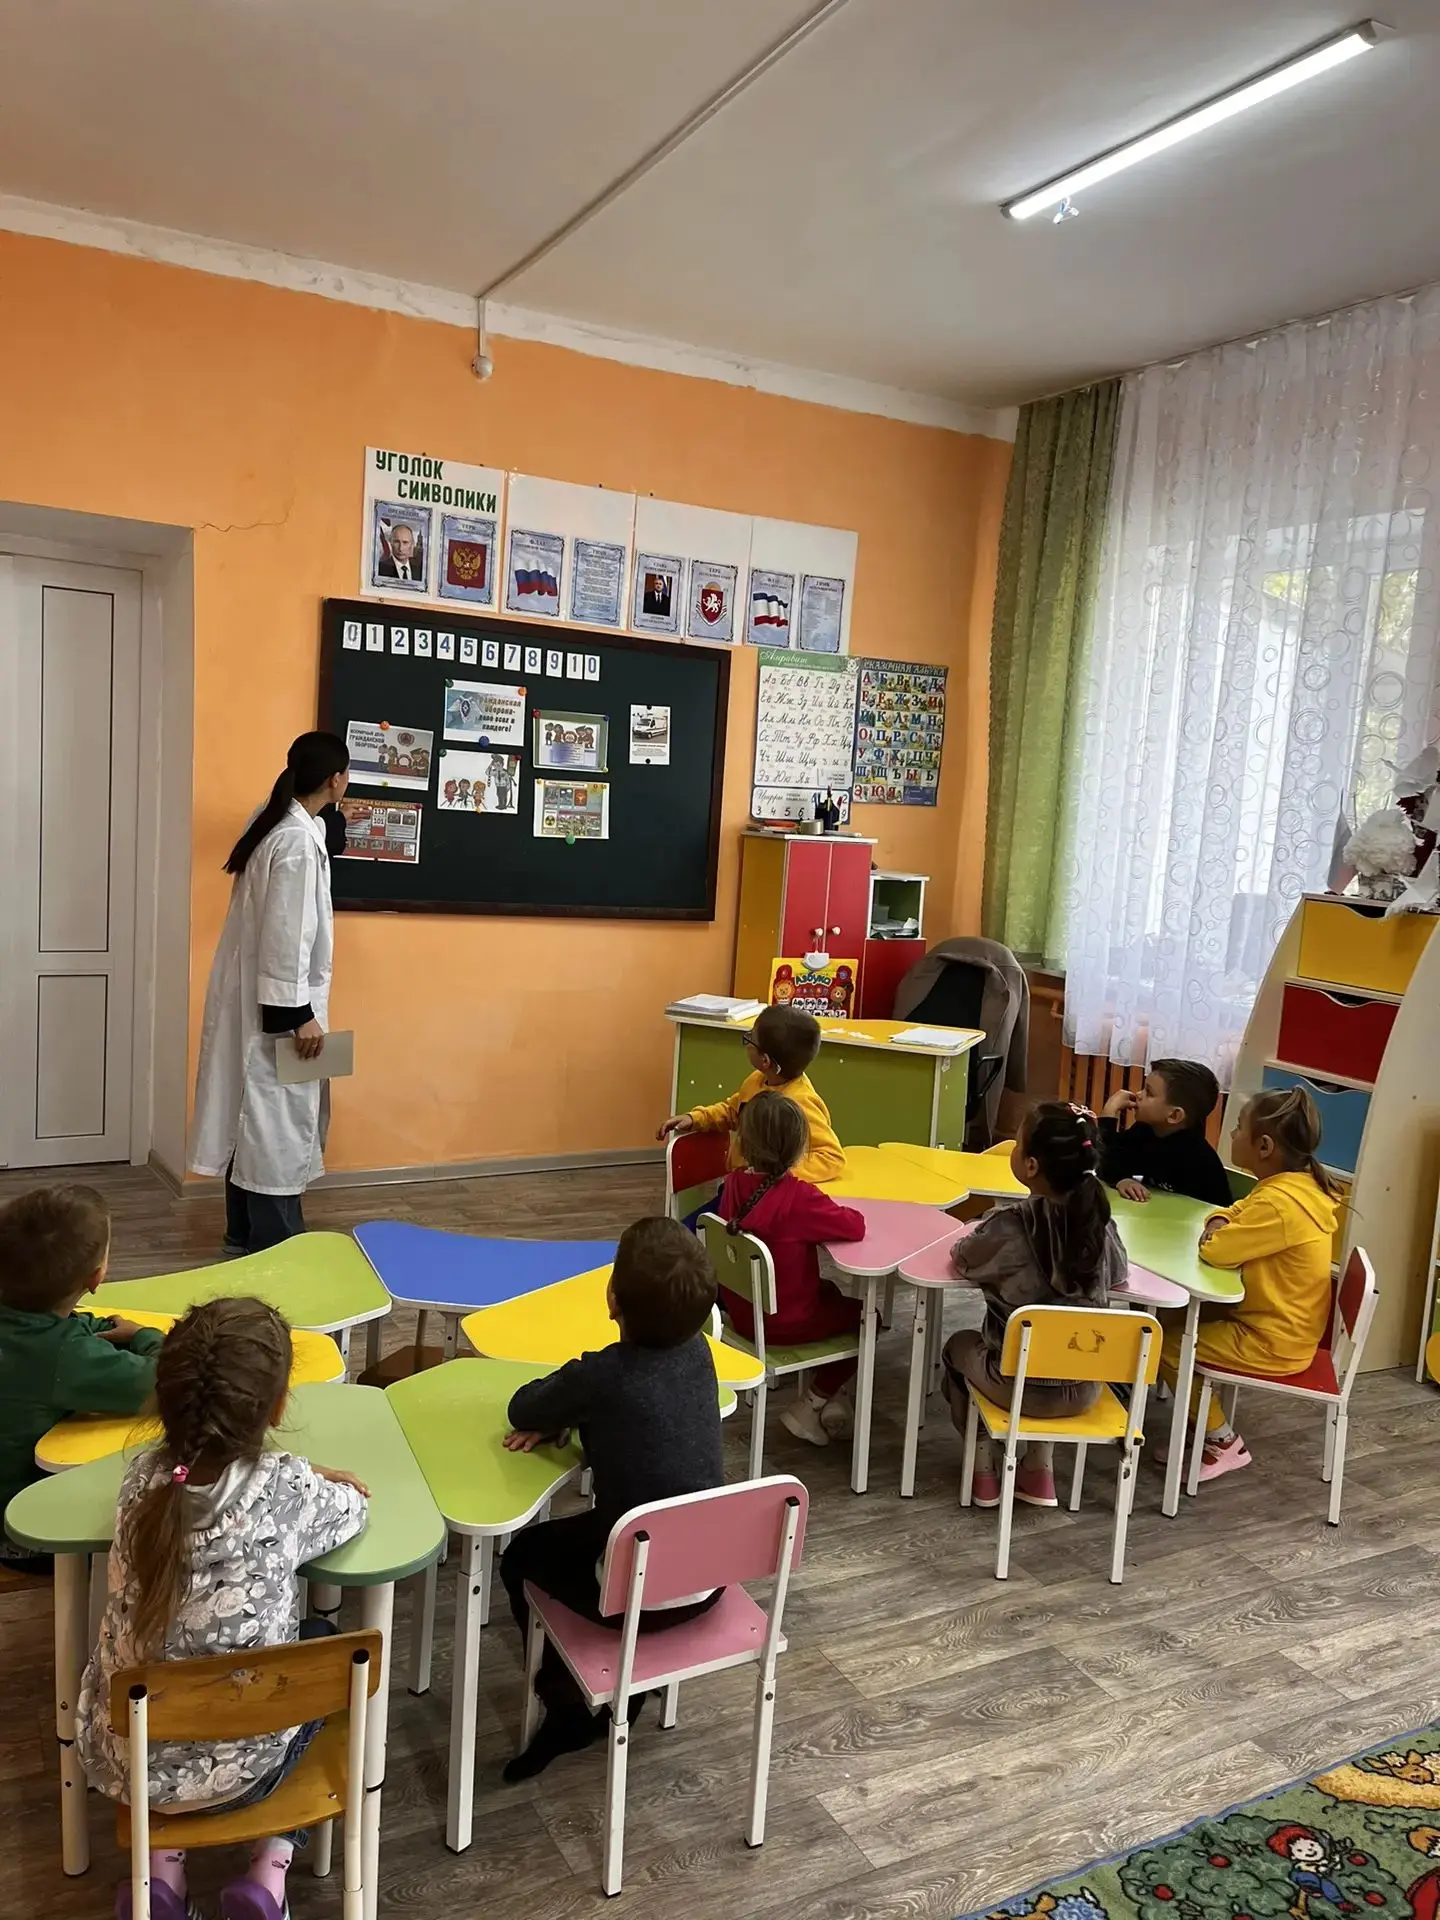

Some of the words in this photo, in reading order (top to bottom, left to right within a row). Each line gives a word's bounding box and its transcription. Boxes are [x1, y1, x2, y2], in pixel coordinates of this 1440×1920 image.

[376, 450, 444, 480] УГОЛОК
[397, 478, 497, 514] СИМВОЛИКИ
[347, 623, 358, 642] 0
[372, 626, 378, 644] 1
[394, 630, 404, 647] 2
[418, 632, 428, 650] 3
[440, 636, 450, 653] 4
[464, 639, 474, 657] 5
[486, 644, 495, 661] 6
[508, 646, 516, 664] 7
[528, 650, 538, 667] 8
[550, 652, 559, 670] 9
[864, 659, 912, 673] СКАЗОЧНАЯ
[862, 671, 872, 684] А
[880, 673, 888, 685] Б
[896, 674, 904, 686] В
[913, 676, 920, 687] Г
[862, 690, 869, 702] Е
[894, 693, 906, 705] Ж
[912, 694, 918, 706] З
[928, 696, 938, 707] И
[877, 711, 886, 722] К
[894, 712, 902, 723] Л
[911, 713, 921, 725] М
[927, 714, 938, 726] Н
[859, 728, 868, 740] О
[876, 730, 886, 741] П
[893, 730, 900, 742] Р
[910, 732, 918, 744] С
[926, 733, 934, 744] Т
[858, 748, 866, 758] У
[874, 748, 884, 760] Ф
[892, 750, 901, 760] Х
[914, 751, 922, 764] Ц
[926, 752, 934, 762] Ч
[856, 766, 867, 776] Ш
[876, 767, 888, 780] Щ
[892, 768, 902, 780] Ъ
[906, 768, 918, 780] Ы
[926, 770, 934, 781] Ь
[854, 784, 862, 797] Э
[871, 786, 885, 797] Ю
[887, 786, 896, 798] Я
[756, 806, 762, 815] 3
[770, 806, 776, 815] 4
[784, 807, 791, 816] 5
[798, 807, 805, 818] 6
[841, 809, 847, 819] 9
[796, 972, 831, 985] Азбука
